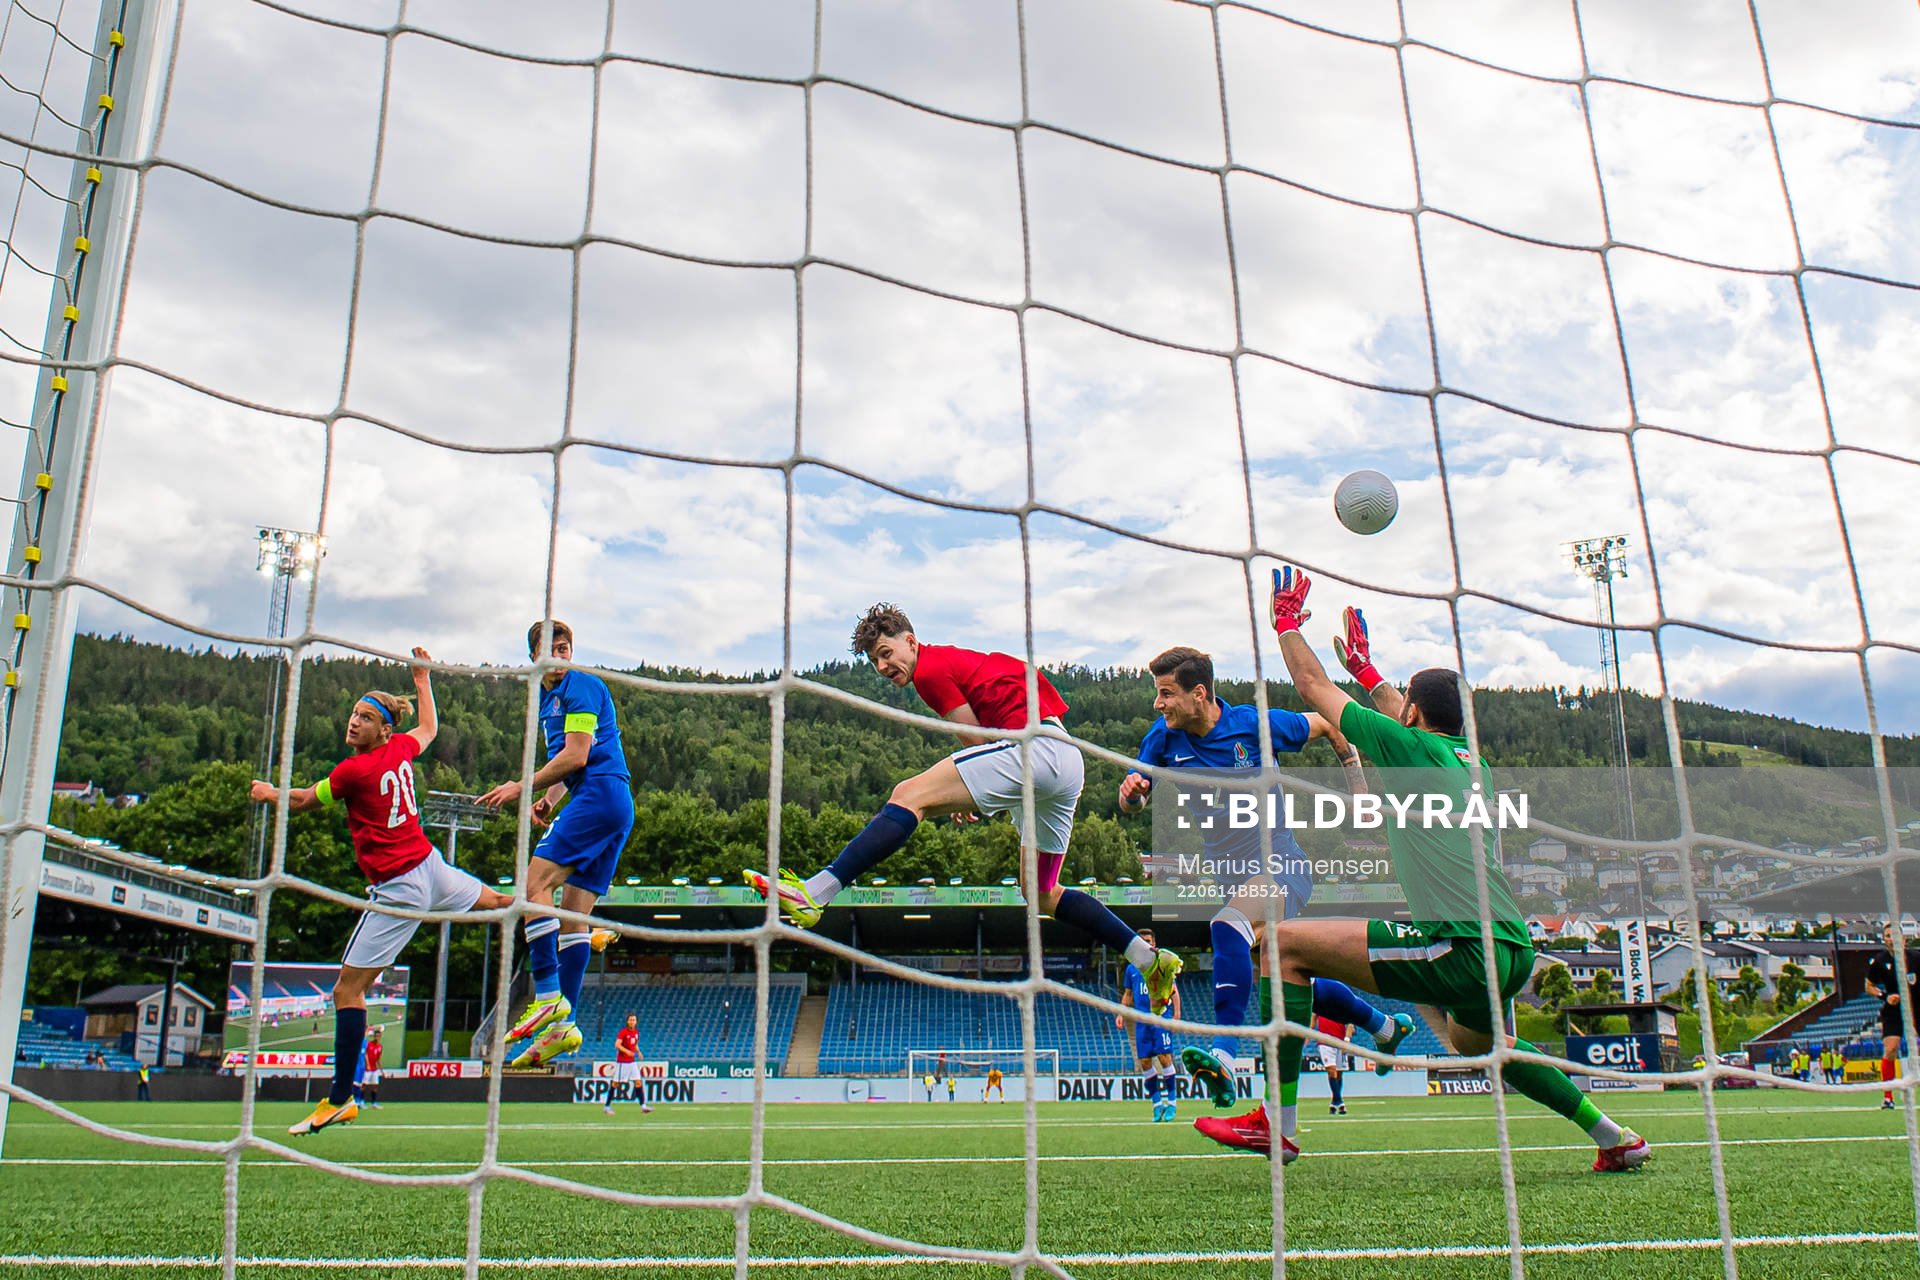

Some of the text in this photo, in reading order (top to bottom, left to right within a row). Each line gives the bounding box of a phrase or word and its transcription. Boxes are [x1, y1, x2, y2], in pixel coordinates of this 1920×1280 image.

[381, 760, 418, 829] 20
[1629, 949, 1643, 981] Block
[1139, 982, 1149, 996] 16
[1161, 1032, 1171, 1046] 16
[1587, 1037, 1641, 1065] ecit
[412, 1064, 458, 1077] RVS AS
[598, 1063, 664, 1078] Con
[674, 1064, 717, 1078] leadly
[1058, 1078, 1114, 1101] DAILY
